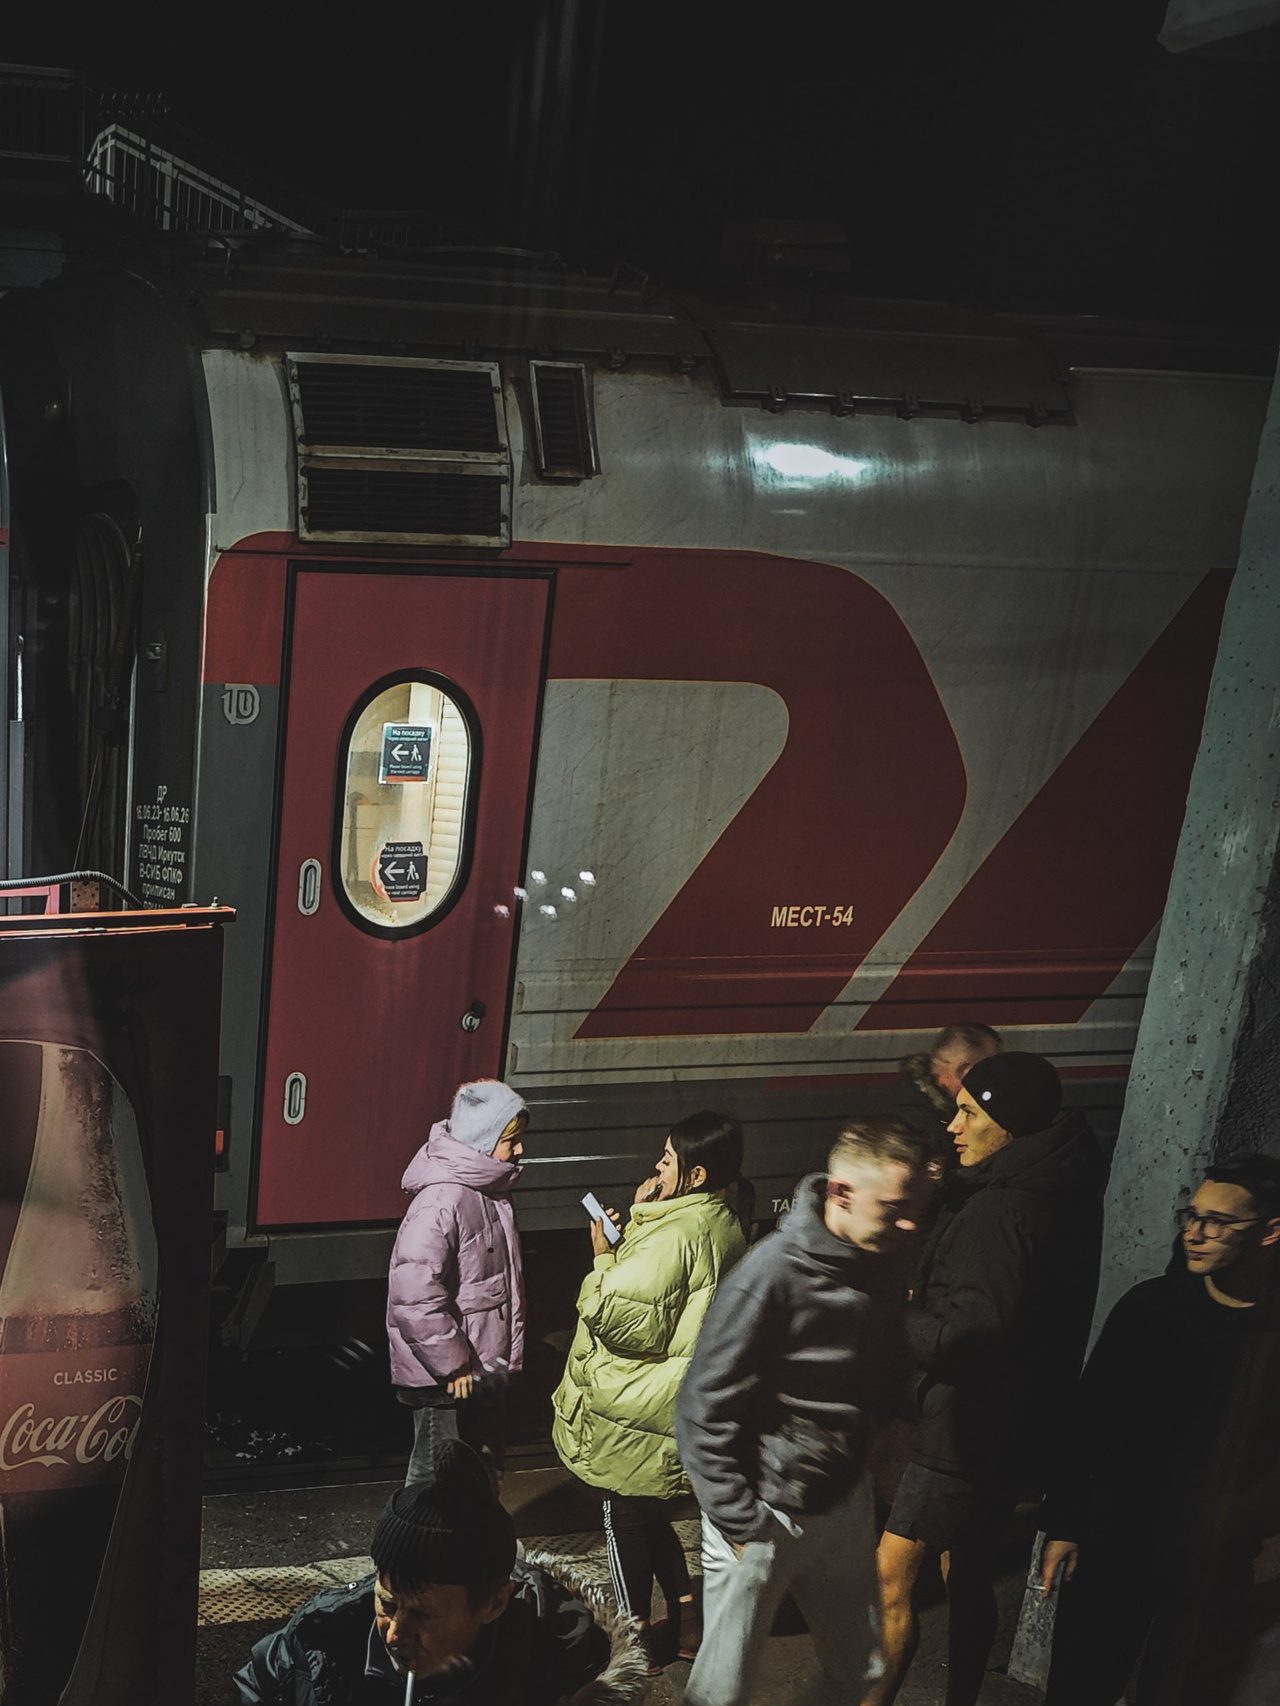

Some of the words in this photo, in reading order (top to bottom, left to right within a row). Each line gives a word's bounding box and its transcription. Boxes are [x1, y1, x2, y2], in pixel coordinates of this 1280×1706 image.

[157, 785, 168, 803] ДР
[143, 824, 168, 843] Пробег
[169, 826, 182, 843] 600
[138, 844, 157, 863] ЛВЧД
[158, 845, 185, 866] Иркутск
[139, 862, 161, 880] В-СИБ
[142, 883, 175, 901] приписан
[770, 905, 854, 927] МЕСТ-54
[53, 1368, 118, 1386] CLASSIC
